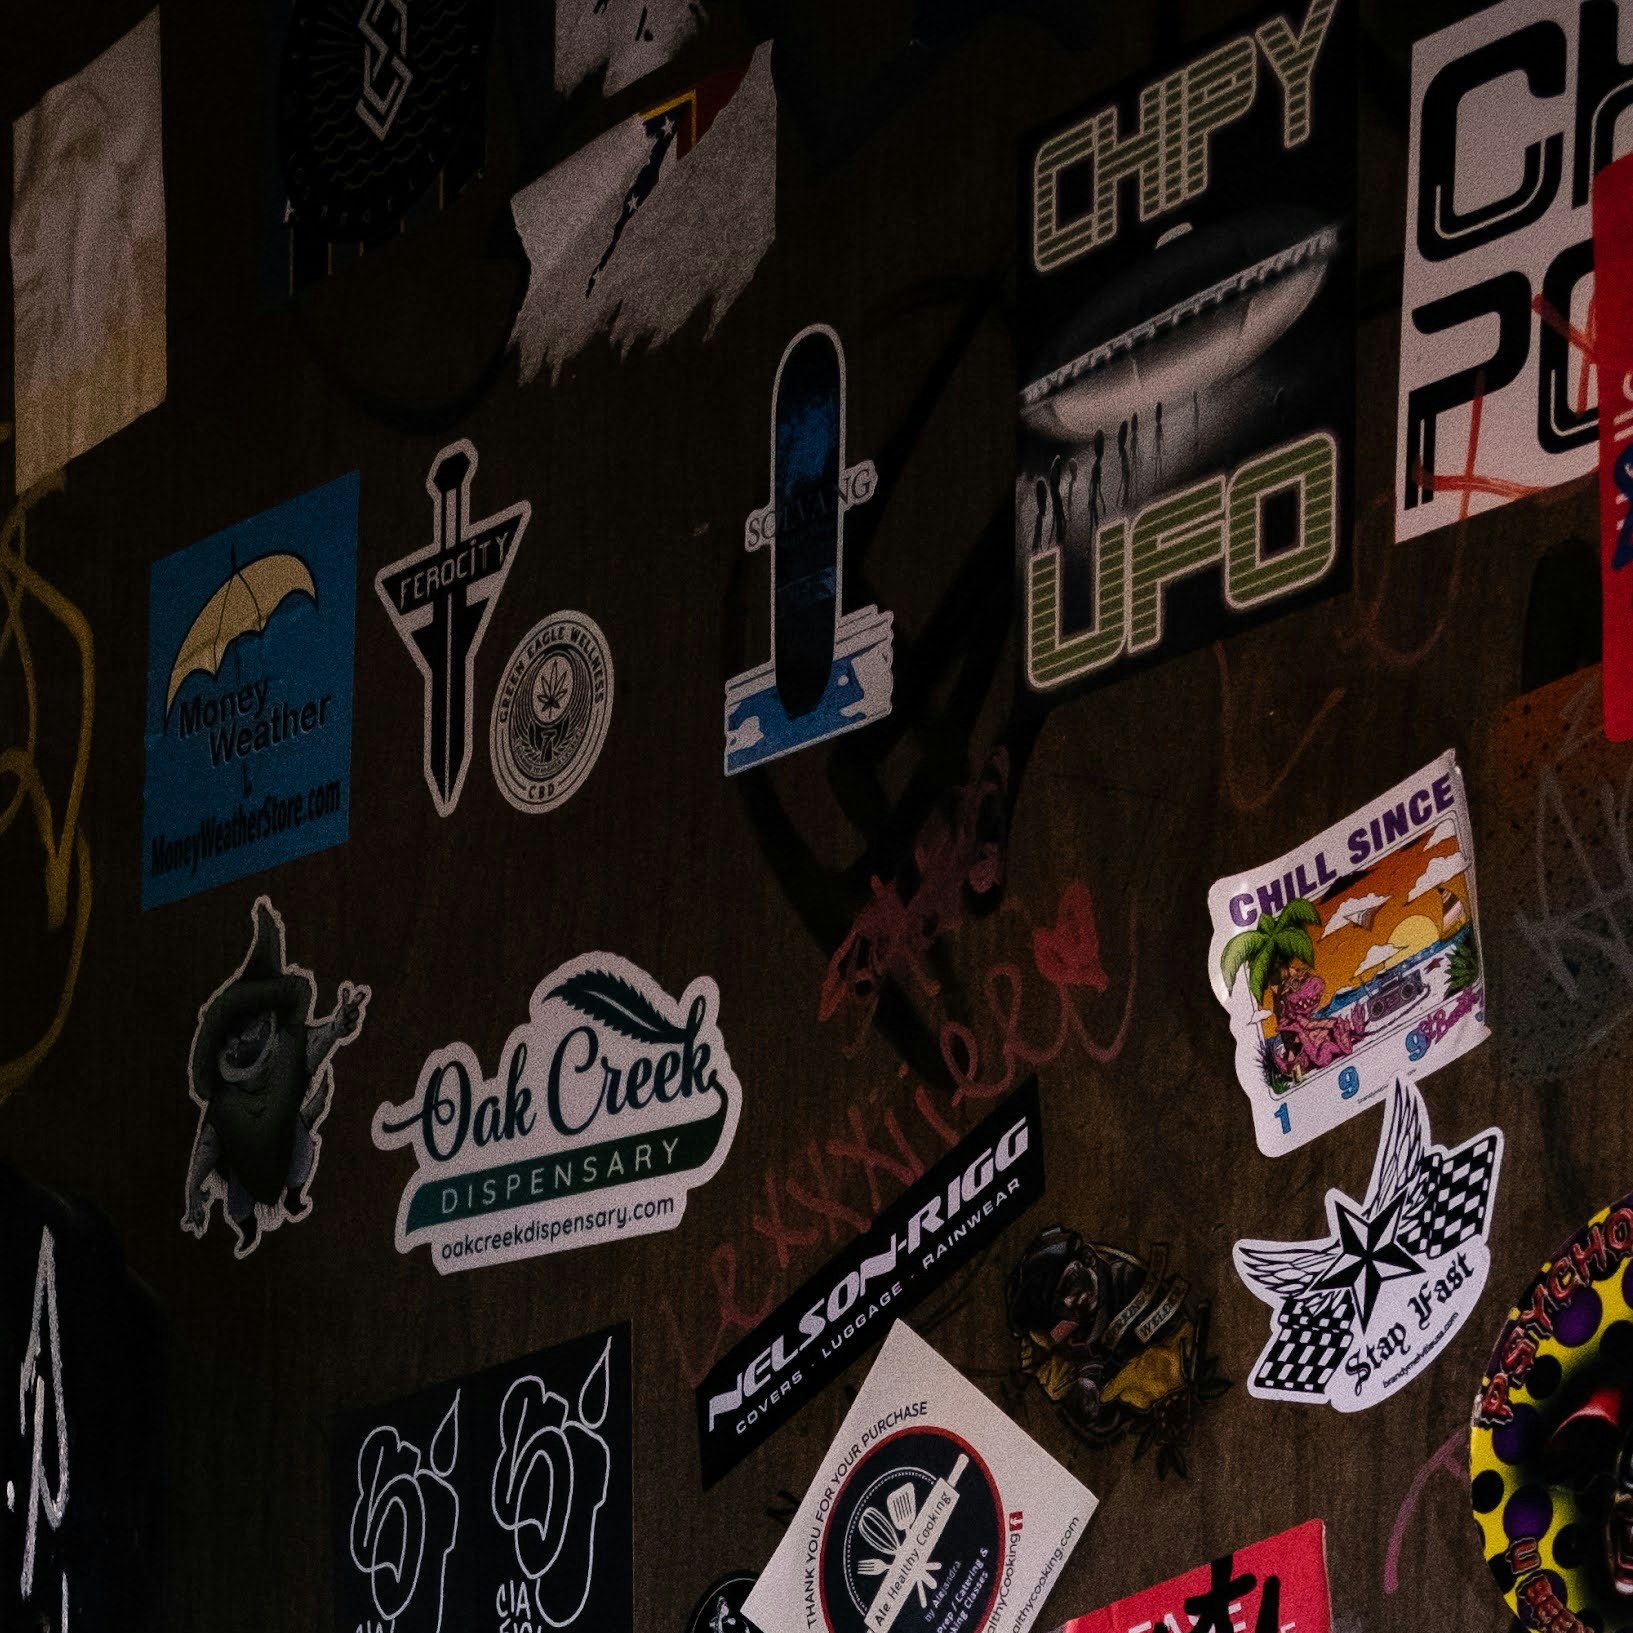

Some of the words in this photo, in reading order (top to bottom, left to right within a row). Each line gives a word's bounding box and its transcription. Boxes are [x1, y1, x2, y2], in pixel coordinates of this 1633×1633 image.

[1026, 431, 1338, 694] UFO
[178, 674, 270, 738] Money
[498, 659, 525, 723] GREEN
[527, 625, 565, 658] EAGLE
[570, 625, 604, 704] WELLNESS
[207, 694, 332, 768] Weather
[151, 781, 341, 877] MoneyWeatherStore.com
[528, 783, 555, 799] CBD
[1228, 852, 1338, 931] CHILL
[1346, 774, 1455, 866] SINCE
[382, 1048, 538, 1165] Oak
[547, 995, 727, 1140] Creek
[1273, 1100, 1293, 1136] 1
[1337, 1065, 1360, 1100] 9
[441, 1137, 682, 1216] DISPENSARY
[441, 1194, 675, 1262] oakcreekdispensary.com
[707, 1115, 1030, 1434] NELSON-RIGG
[736, 1370, 804, 1434] COVERS
[820, 1281, 905, 1360] LUGGAGE
[922, 1177, 1022, 1271] RAINWEAR
[1345, 1319, 1413, 1390] Stay
[1418, 1249, 1476, 1329] Fast
[859, 1400, 930, 1449] PURCHASE
[830, 1447, 861, 1491] YOUR
[814, 1489, 834, 1527] FOR
[886, 1547, 921, 1600] Healthy
[917, 1489, 954, 1549] Cooking
[808, 1527, 823, 1572] YOU
[806, 1575, 818, 1630] THANK
